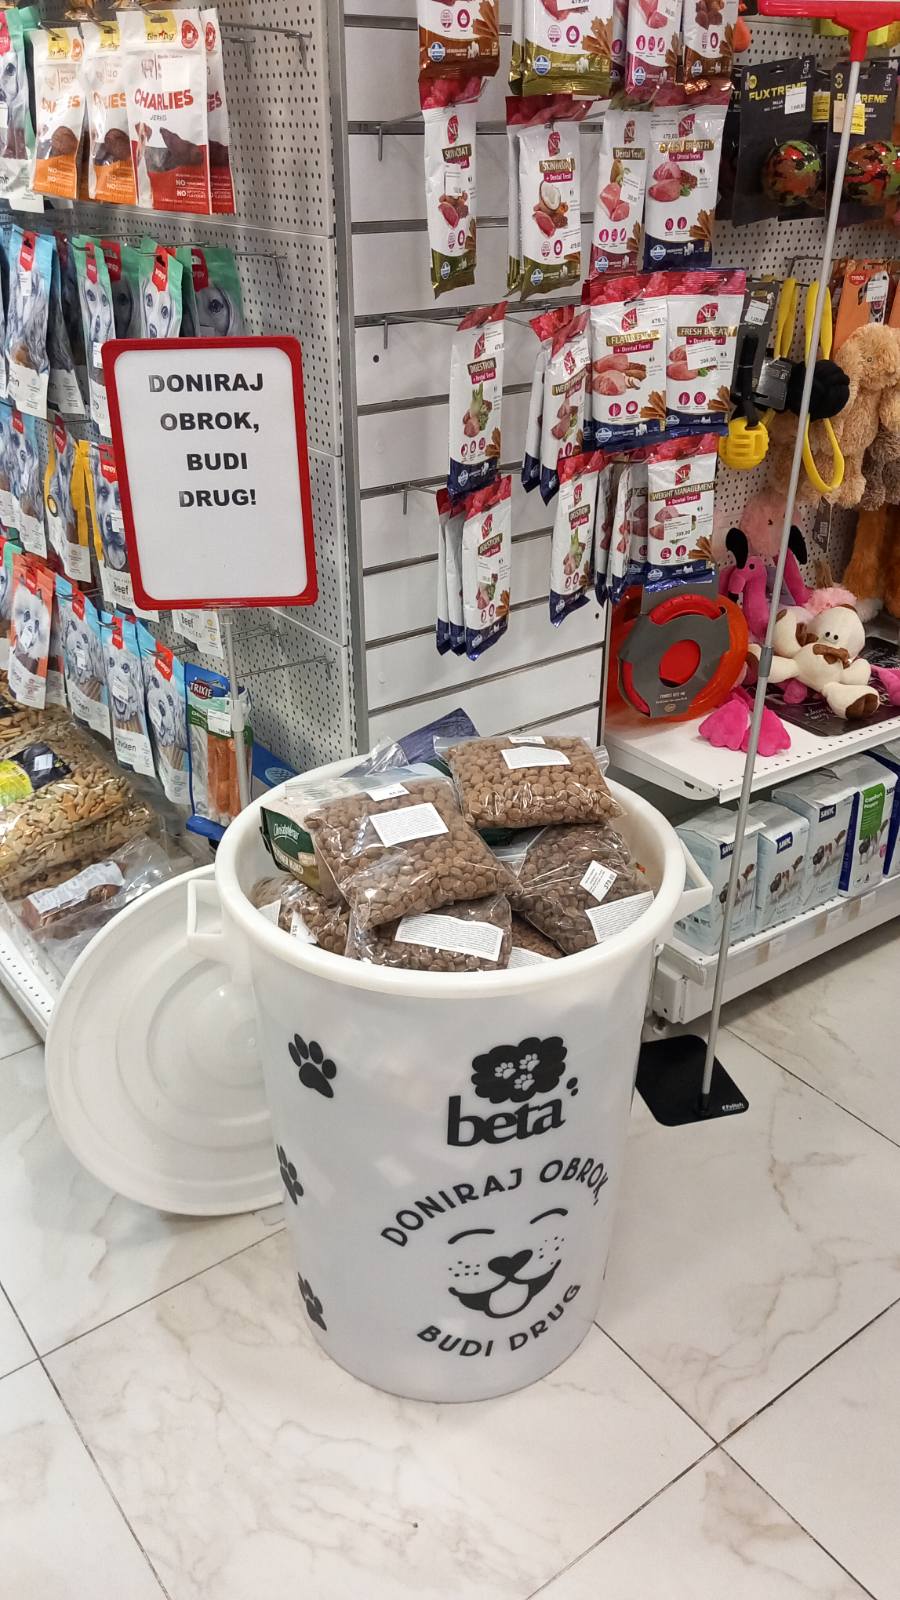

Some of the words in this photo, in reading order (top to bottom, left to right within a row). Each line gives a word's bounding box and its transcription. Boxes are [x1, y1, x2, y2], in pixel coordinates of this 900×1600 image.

[135, 88, 193, 111] CHARLIES
[681, 327, 702, 336] FRESH
[149, 373, 264, 393] DONIRAJ
[160, 411, 260, 433] OBROK,
[187, 453, 248, 471] BUDI
[179, 489, 257, 508] DRUG!
[190, 682, 214, 698] TRIXIE
[447, 1095, 567, 1147] beta
[381, 1167, 523, 1247] DONIRAJ
[539, 1156, 609, 1206] OBROK,
[417, 1324, 494, 1357] BUDI
[509, 1284, 582, 1352] DRUG
